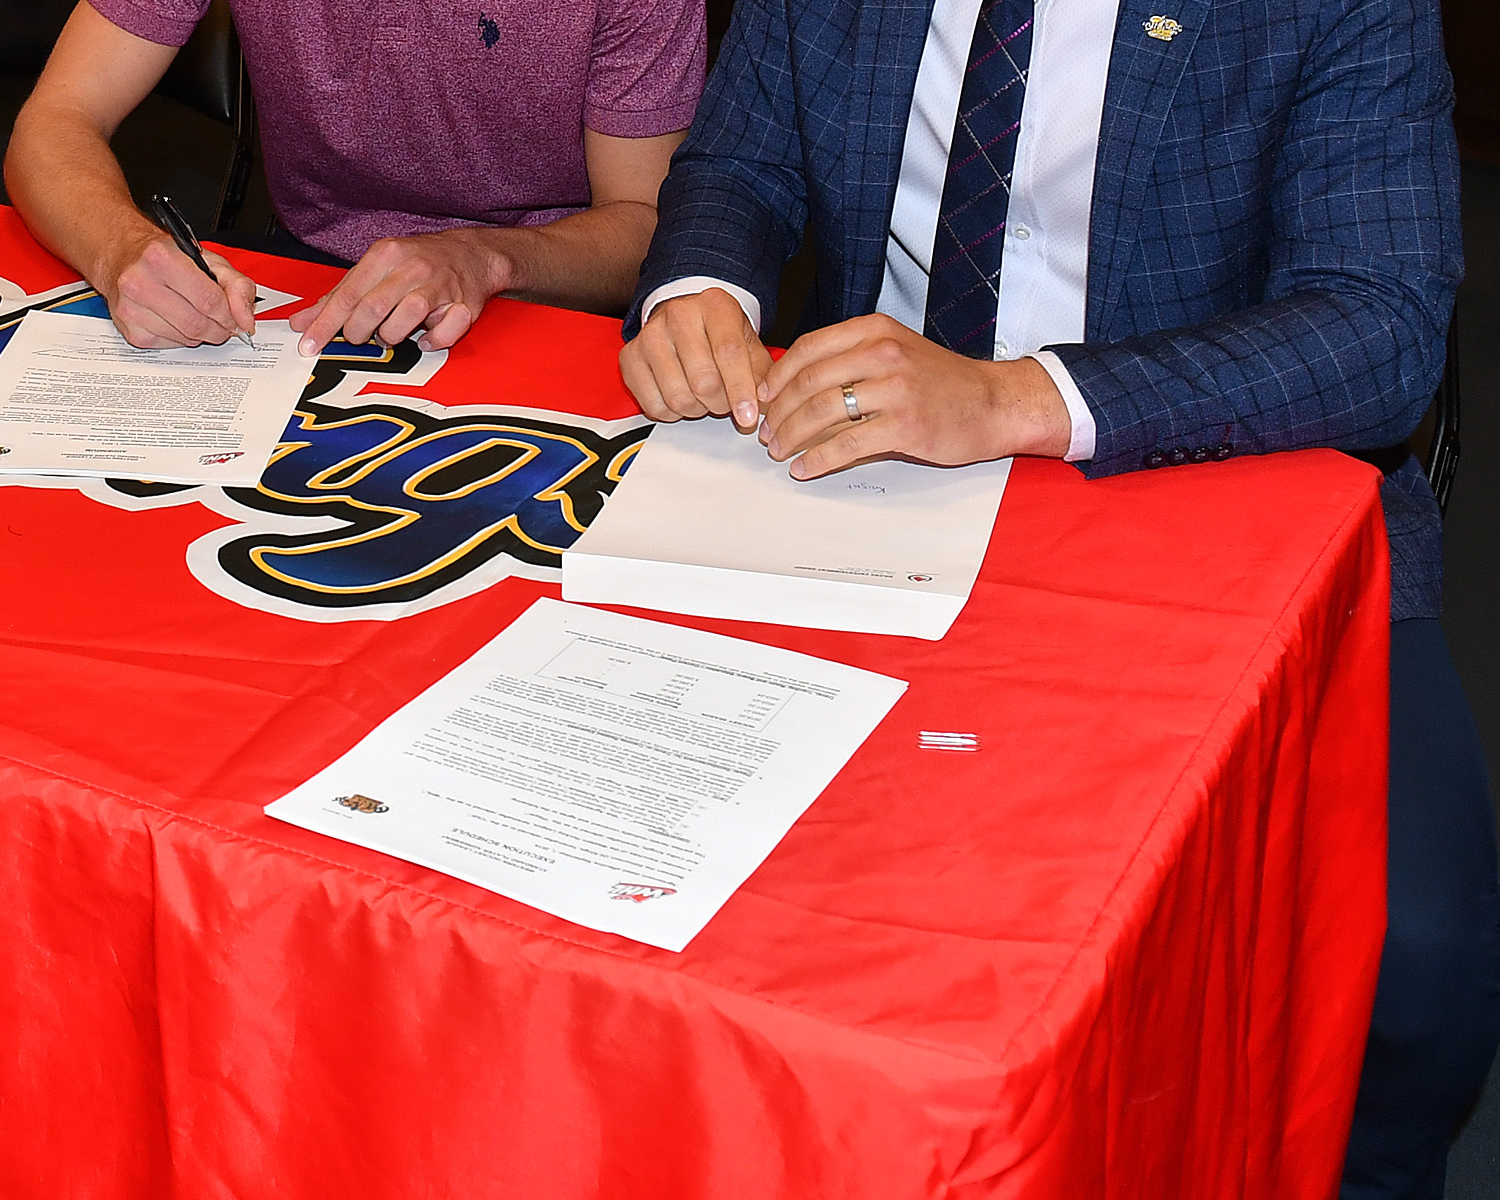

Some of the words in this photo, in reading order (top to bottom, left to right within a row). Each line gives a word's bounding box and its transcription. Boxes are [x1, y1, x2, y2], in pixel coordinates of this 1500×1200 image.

[450, 827, 502, 850] SCHEDULE
[500, 842, 557, 864] EXECUTION
[609, 883, 663, 900] WHL
